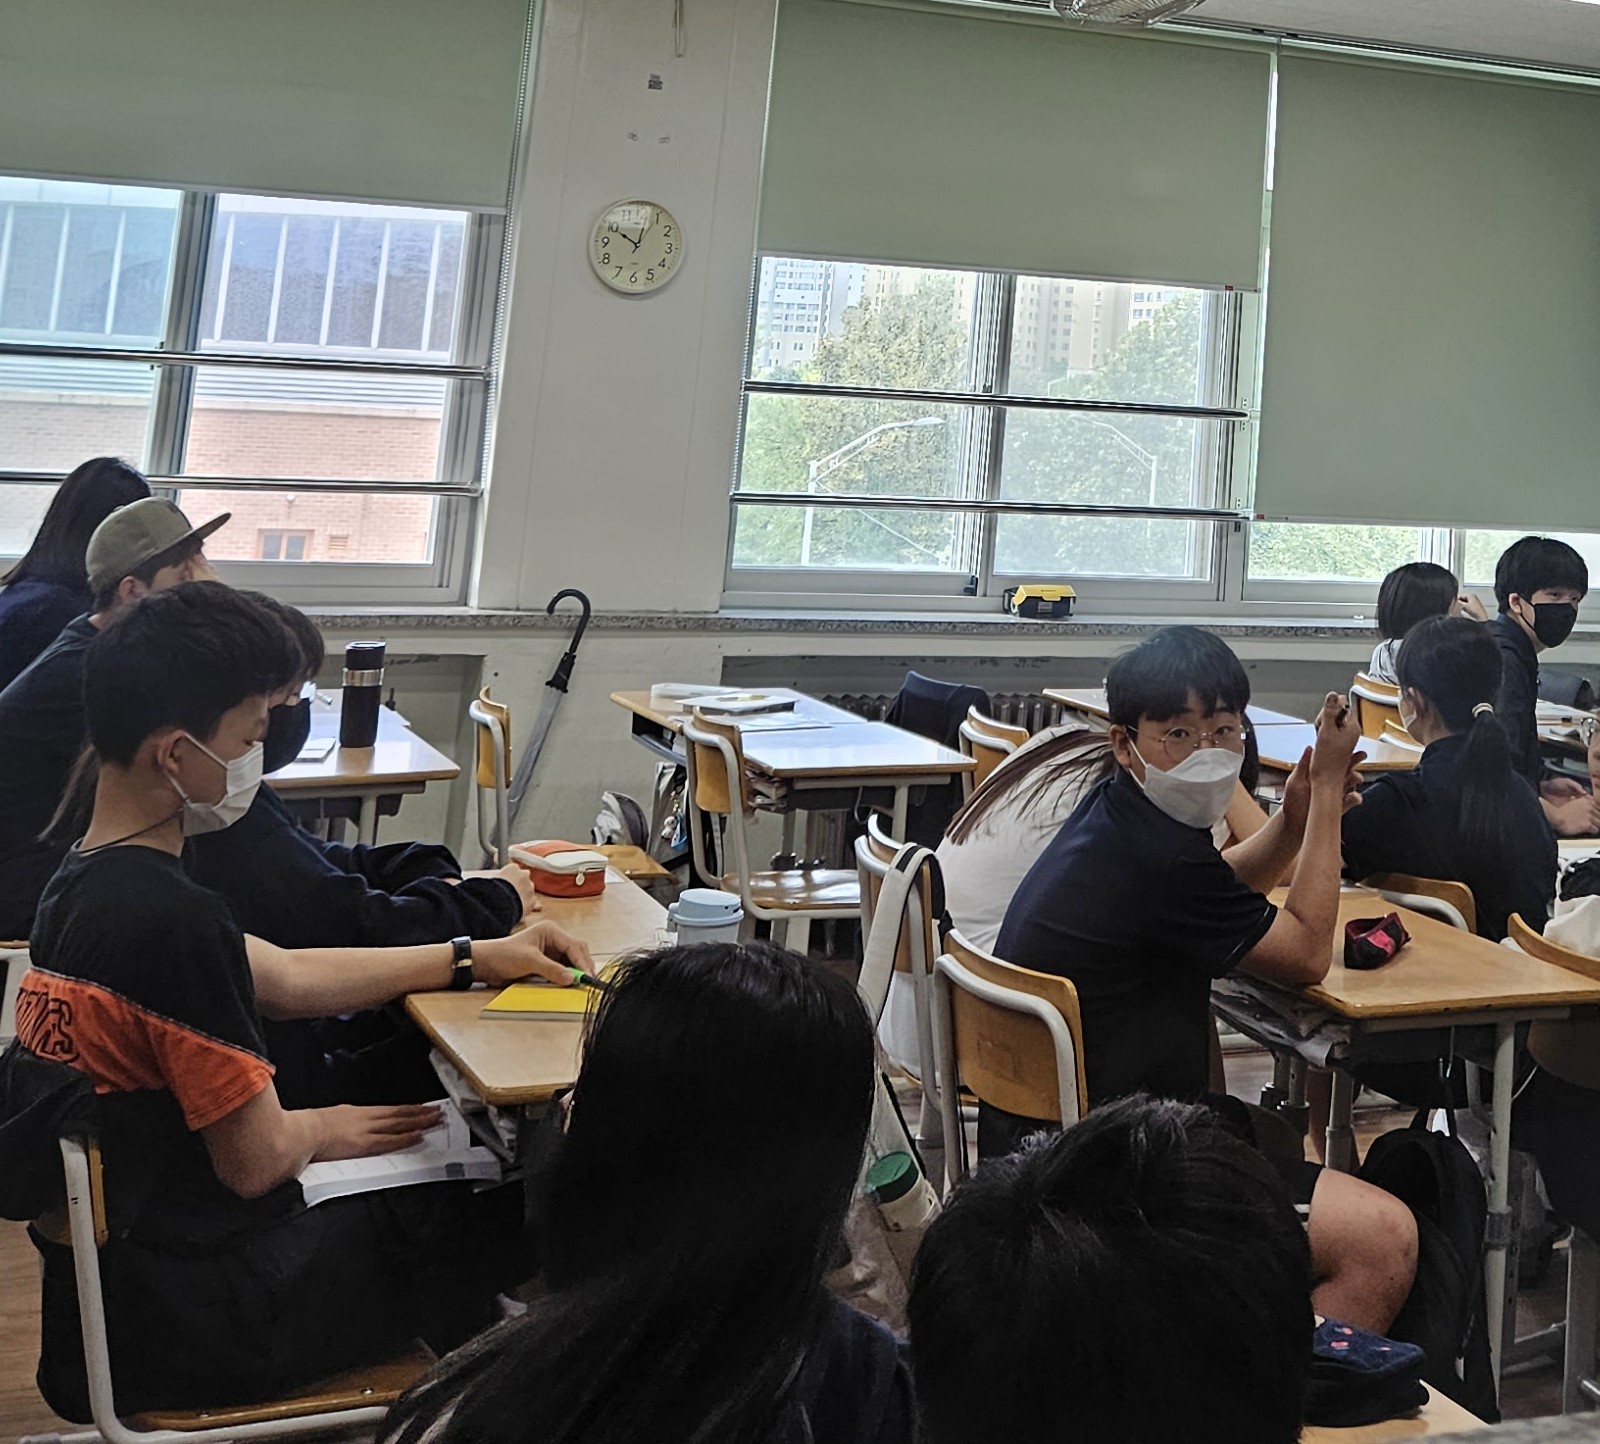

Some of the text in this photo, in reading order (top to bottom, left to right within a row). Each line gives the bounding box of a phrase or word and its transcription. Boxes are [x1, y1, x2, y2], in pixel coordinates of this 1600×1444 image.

[655, 212, 660, 225] 1
[607, 221, 619, 233] 10
[663, 225, 672, 238] 2
[601, 236, 610, 249] 9
[664, 242, 673, 254] 3
[602, 252, 611, 265] 8
[657, 257, 666, 269] 4
[615, 265, 623, 278] 7
[629, 270, 638, 284] 6
[645, 268, 655, 281] 5
